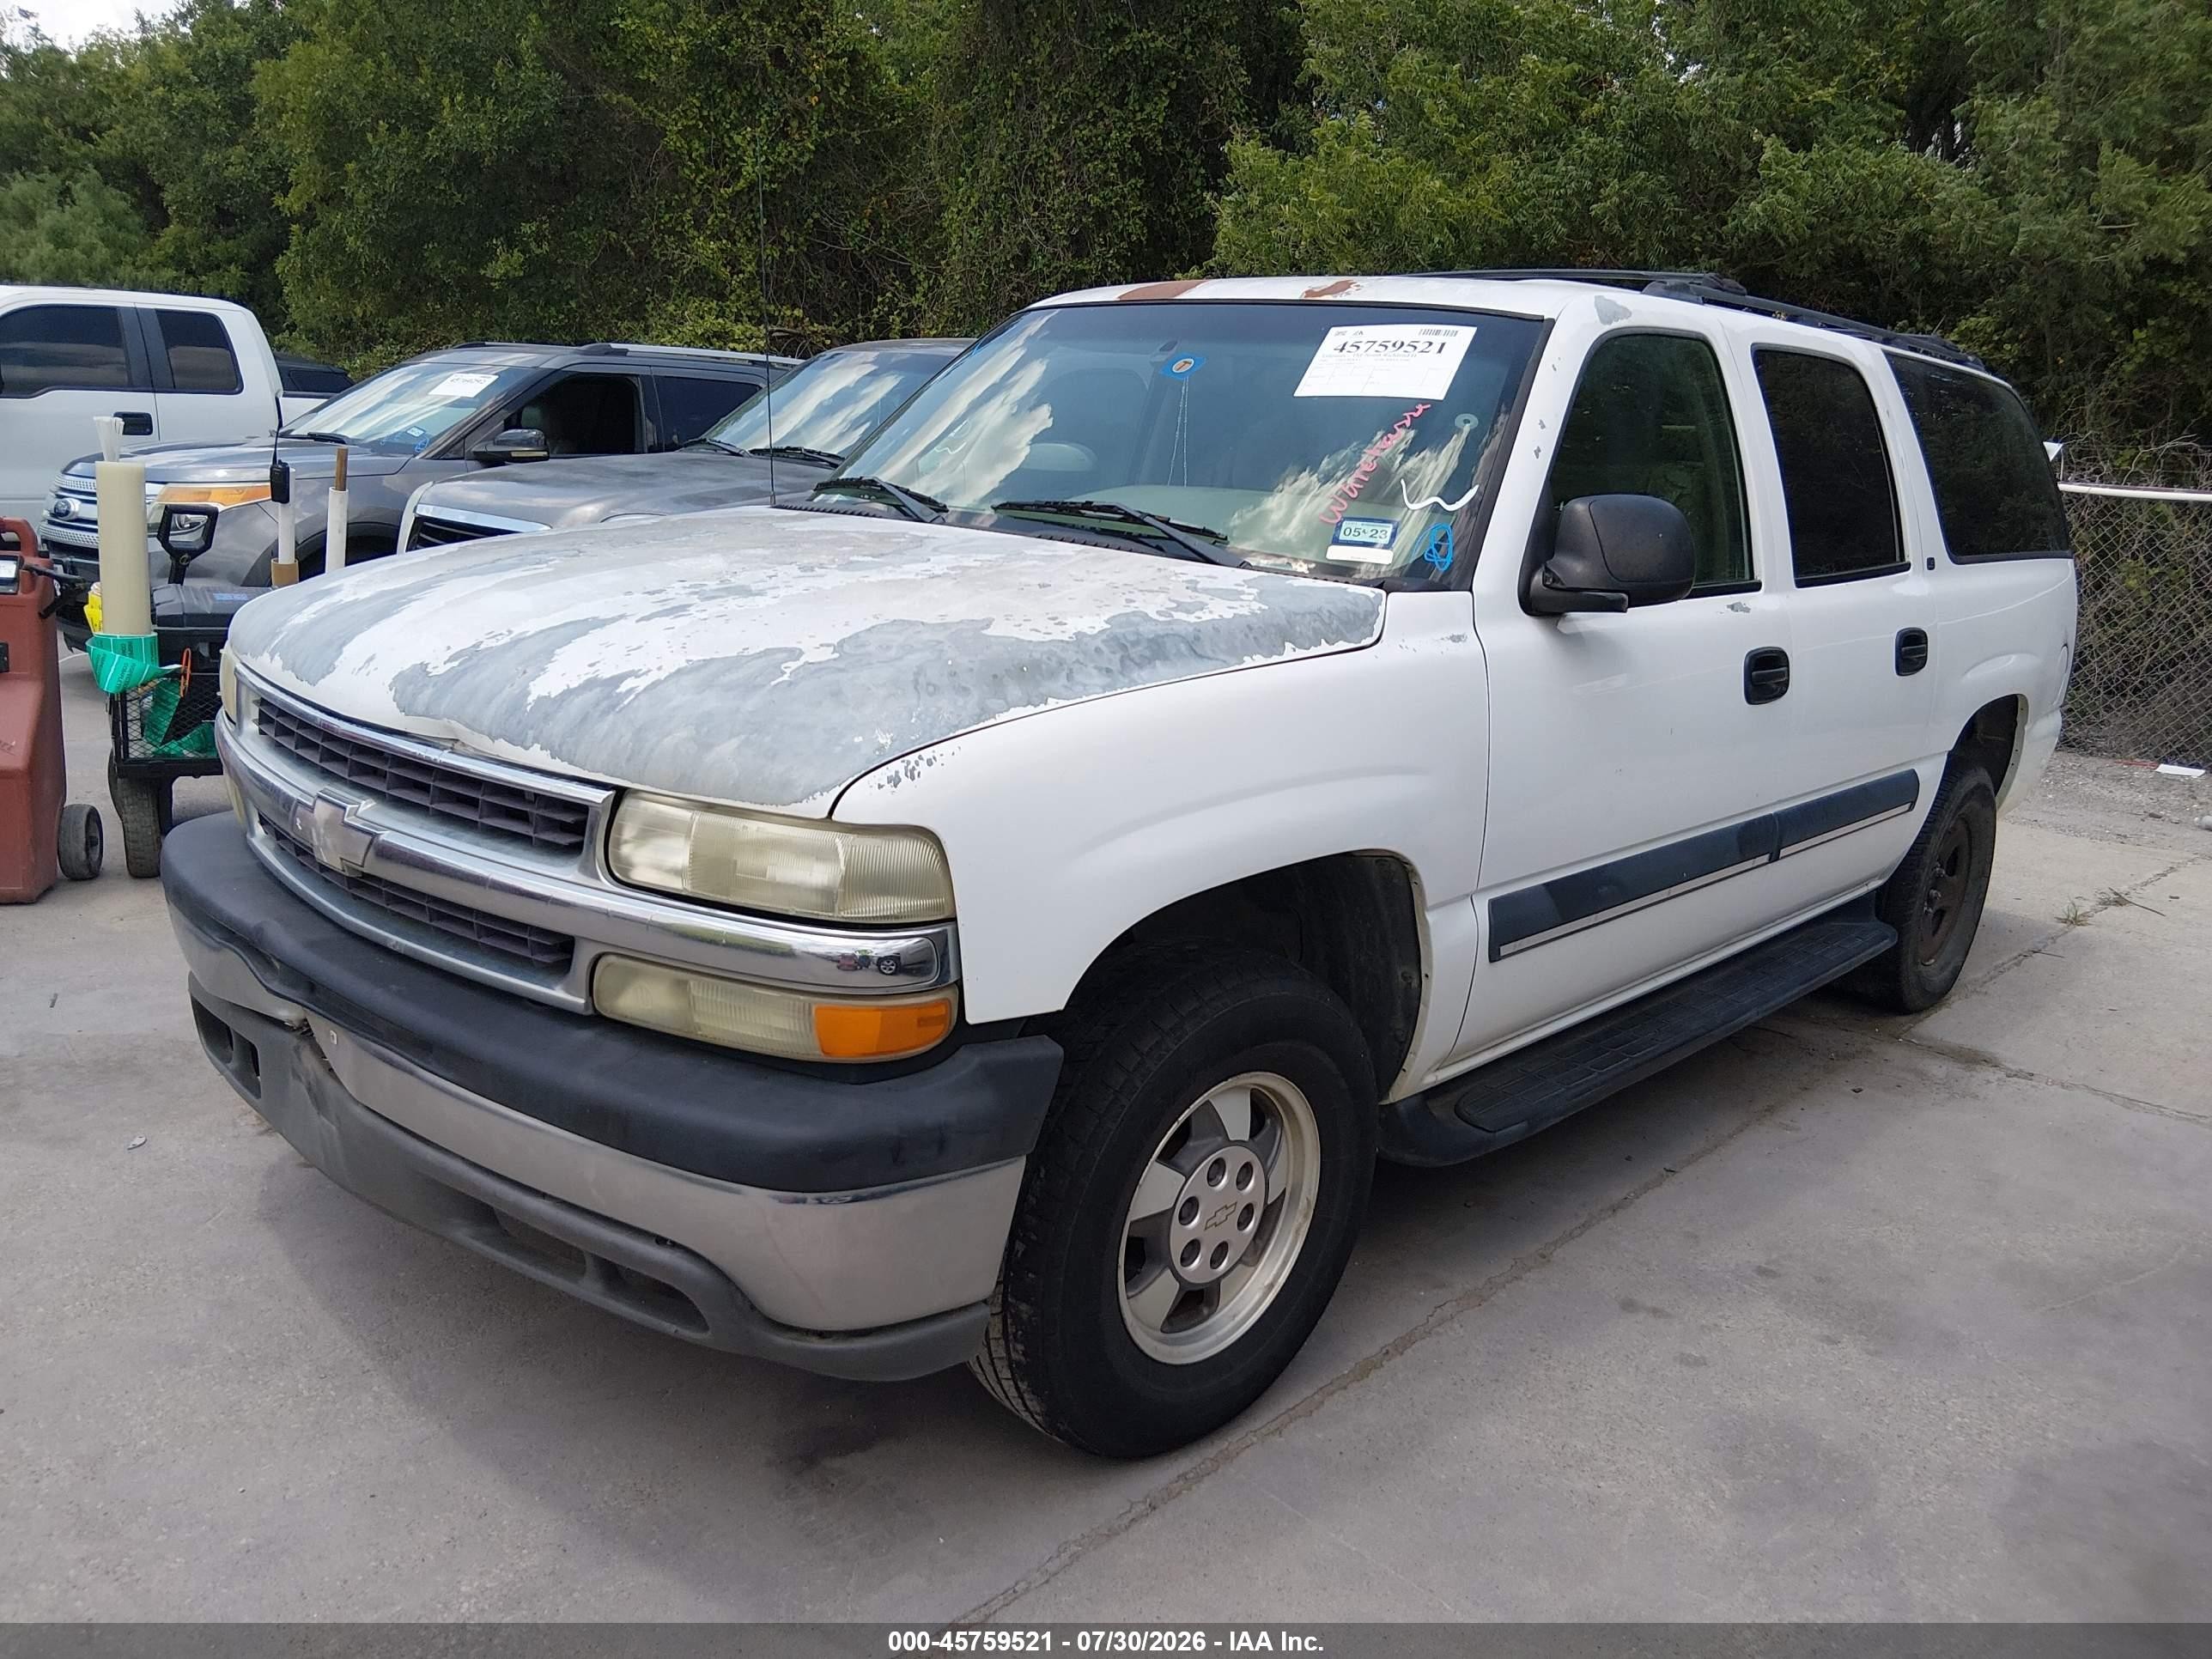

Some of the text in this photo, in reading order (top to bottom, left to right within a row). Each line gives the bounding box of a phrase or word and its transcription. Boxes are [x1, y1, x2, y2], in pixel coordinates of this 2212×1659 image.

[1334, 340, 1447, 354] 45759521
[1343, 526, 1388, 539] 05 23
